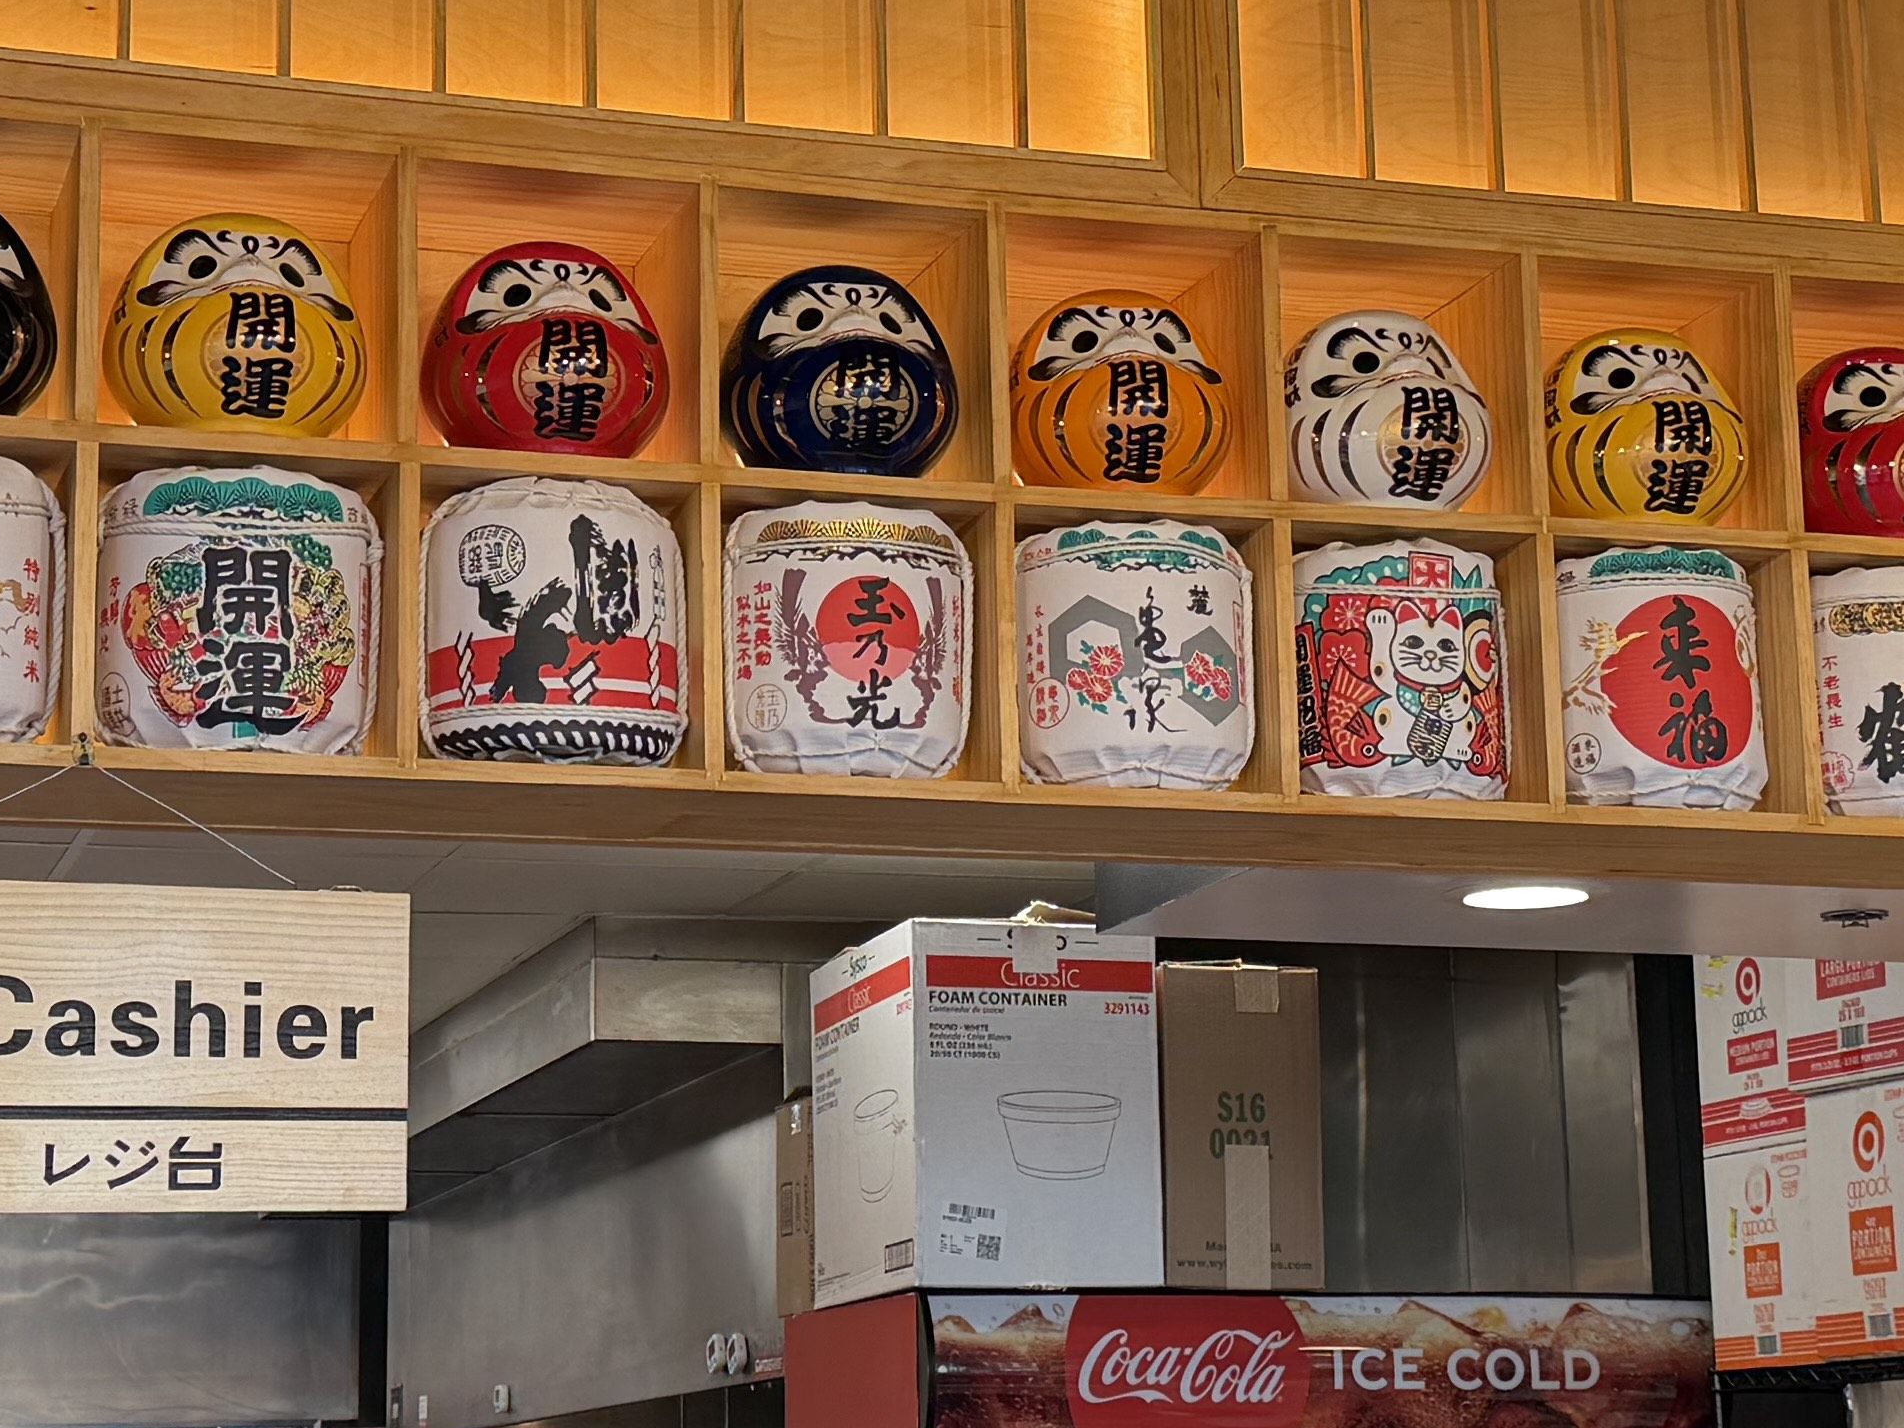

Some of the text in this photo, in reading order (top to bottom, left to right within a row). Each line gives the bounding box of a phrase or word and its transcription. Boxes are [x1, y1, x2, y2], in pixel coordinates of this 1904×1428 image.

[220, 292, 296, 419] 開運
[532, 319, 608, 442] 開運
[1102, 360, 1168, 484] 開運
[1388, 386, 1461, 502] 開運
[1643, 400, 1712, 515] 開運
[194, 546, 309, 736] 開運
[847, 577, 906, 730] 玉乃光
[929, 991, 1068, 1007] FOAM CONTAINER
[1104, 1002, 1150, 1015] 3291143
[44, 1136, 223, 1191] レジ台
[1217, 1091, 1266, 1123] S16
[1078, 1329, 1295, 1404] Coca-Cola
[1332, 1349, 1600, 1391] ICE COLD
